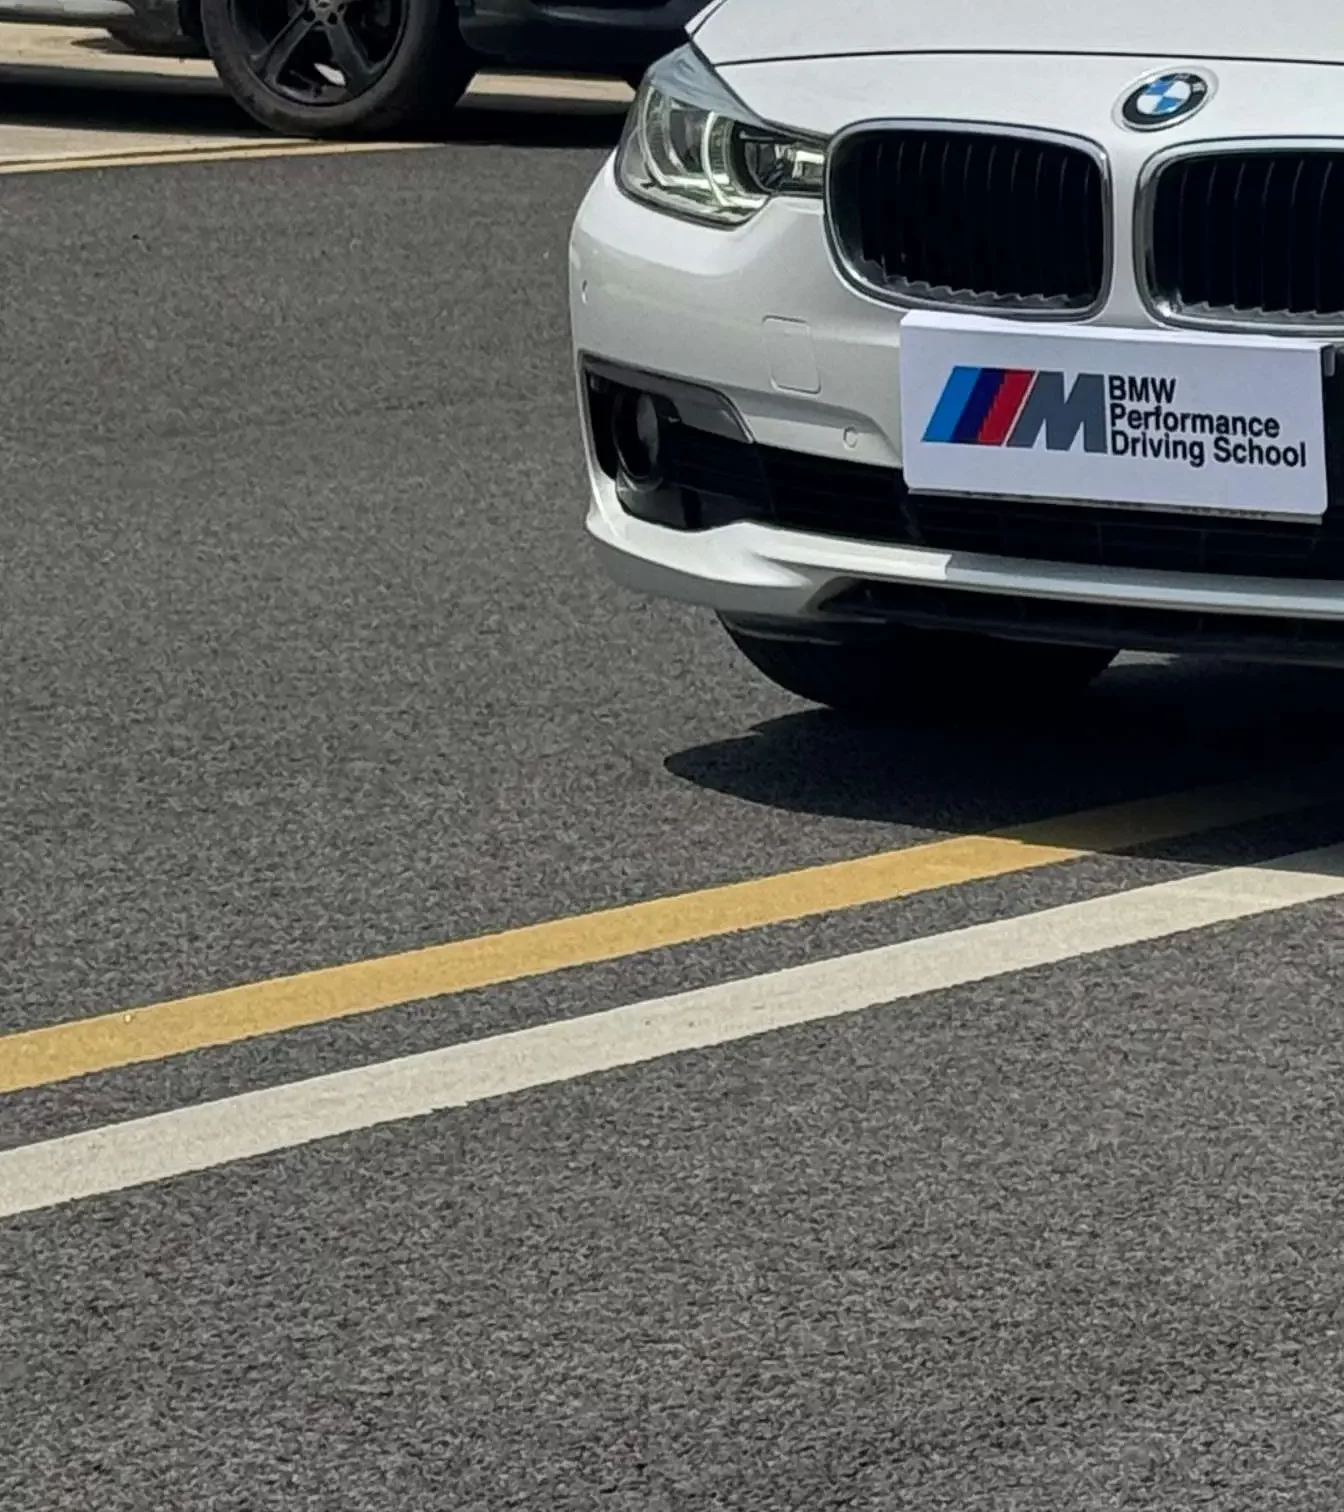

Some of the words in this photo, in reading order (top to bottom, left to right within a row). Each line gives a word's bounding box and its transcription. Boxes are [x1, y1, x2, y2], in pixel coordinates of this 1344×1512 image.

[1108, 374, 1177, 405] BMW
[1110, 402, 1281, 438] Performance
[1111, 430, 1206, 468] Driving
[1212, 436, 1307, 468] School
